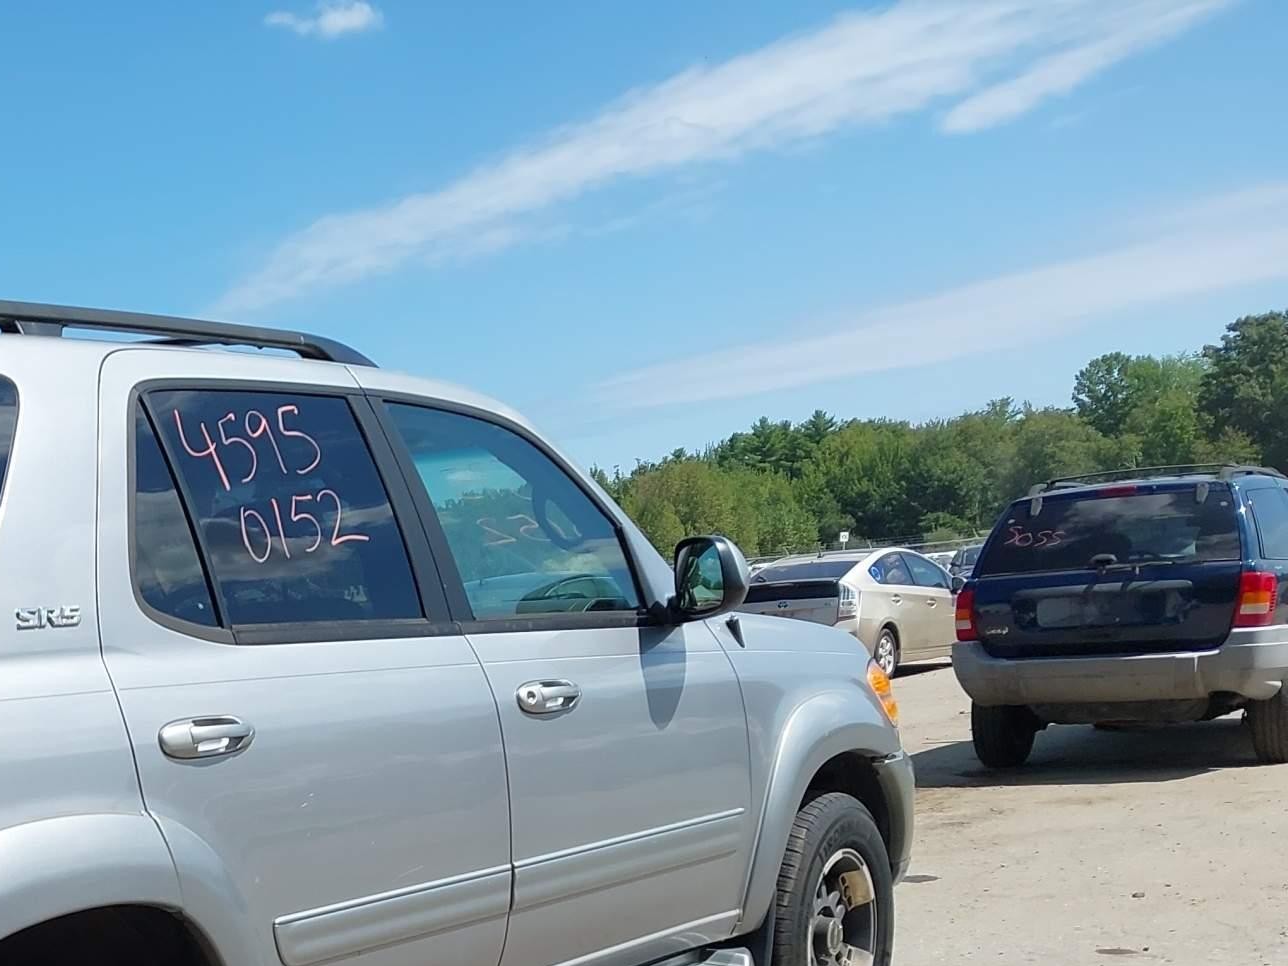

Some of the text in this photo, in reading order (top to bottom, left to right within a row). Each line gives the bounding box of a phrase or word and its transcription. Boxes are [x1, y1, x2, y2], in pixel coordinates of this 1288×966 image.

[174, 405, 322, 492] 4595
[240, 489, 370, 563] 0152
[15, 605, 81, 631] SR5
